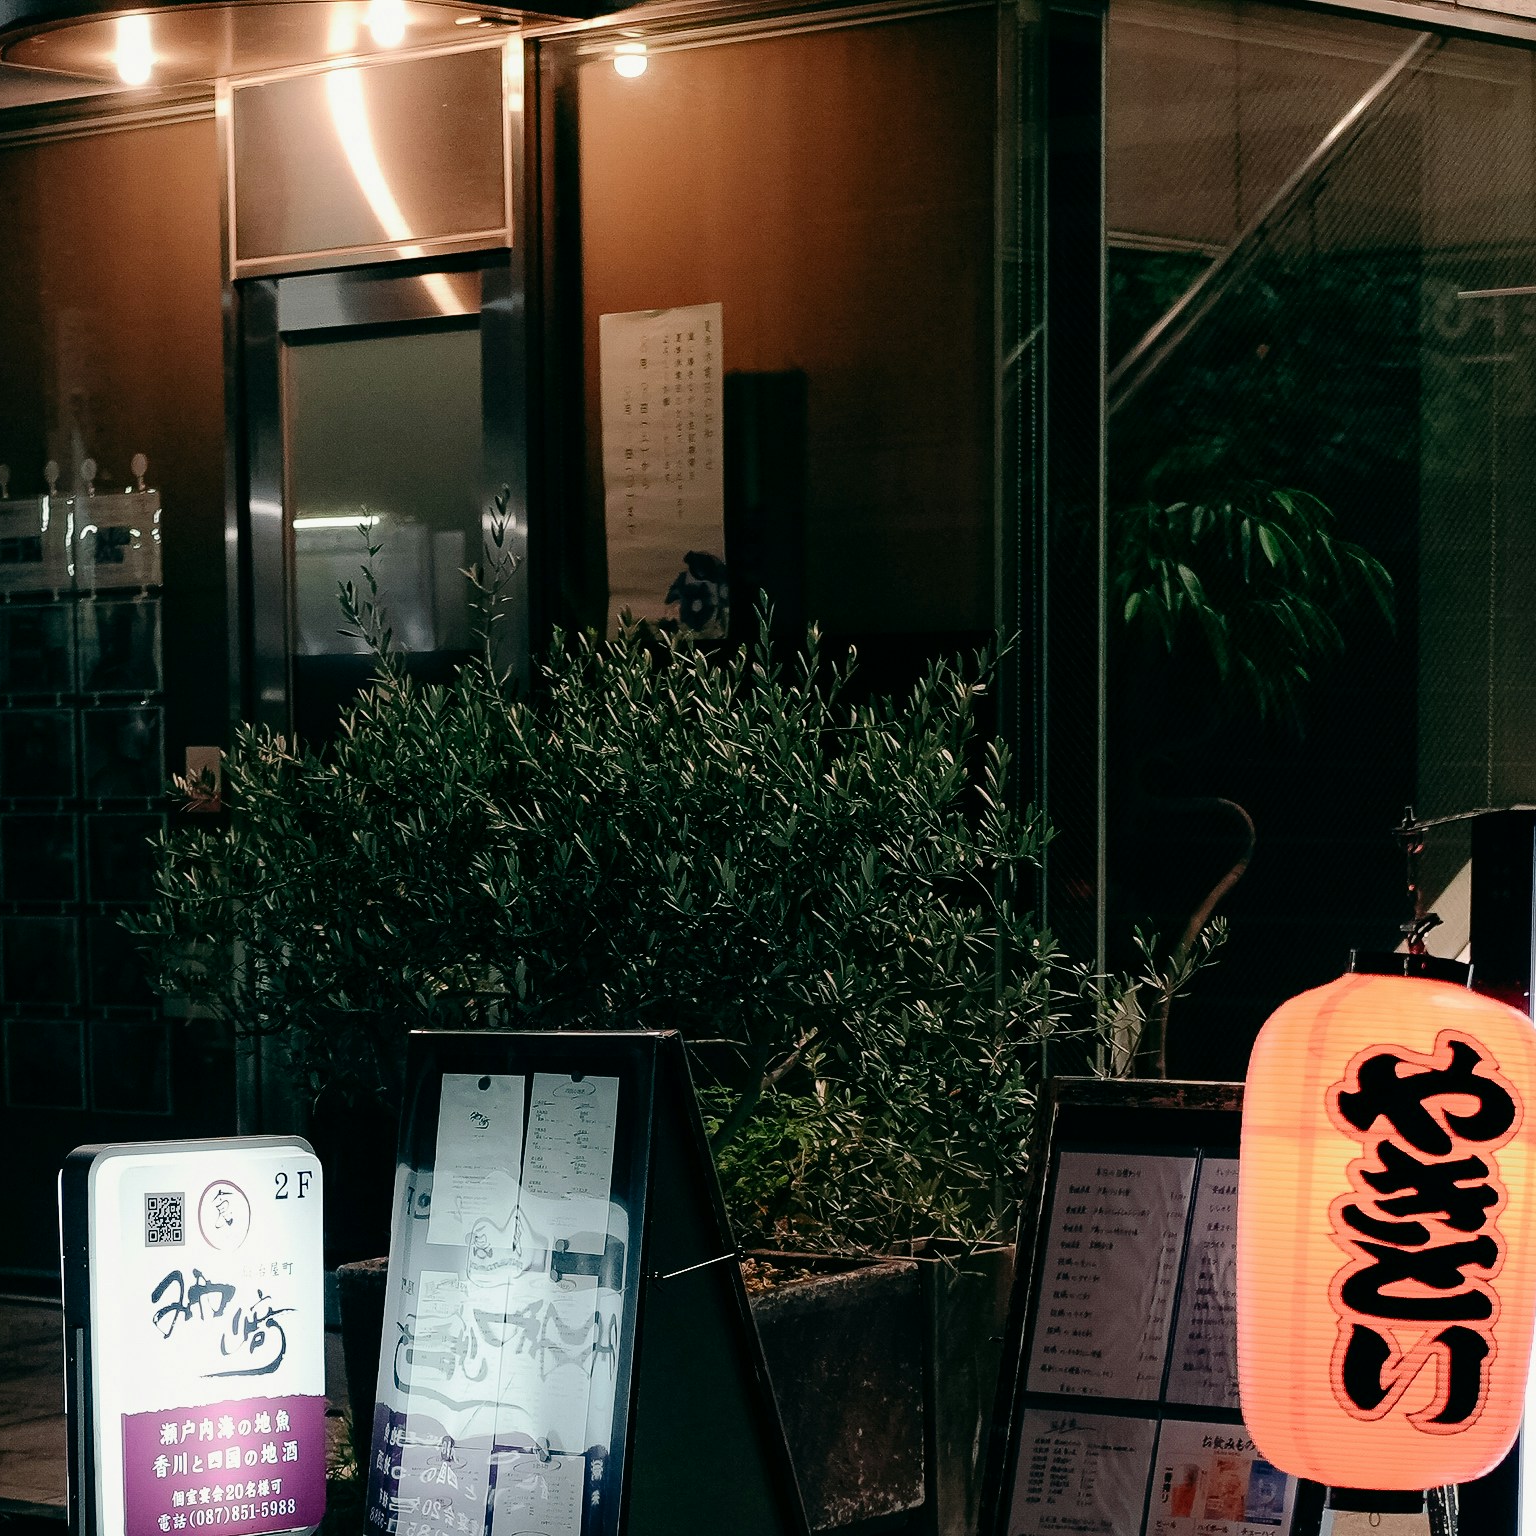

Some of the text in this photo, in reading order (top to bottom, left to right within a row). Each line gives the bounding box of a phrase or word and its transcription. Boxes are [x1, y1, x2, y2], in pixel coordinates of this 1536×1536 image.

[274, 1171, 314, 1200] 2F
[1334, 1037, 1520, 1428] やきとり
[159, 1409, 292, 1445] 瀬戸内海の地魚
[151, 1440, 299, 1478] 香川と四国の地酒
[171, 1478, 283, 1508] 個室宴会20名様可
